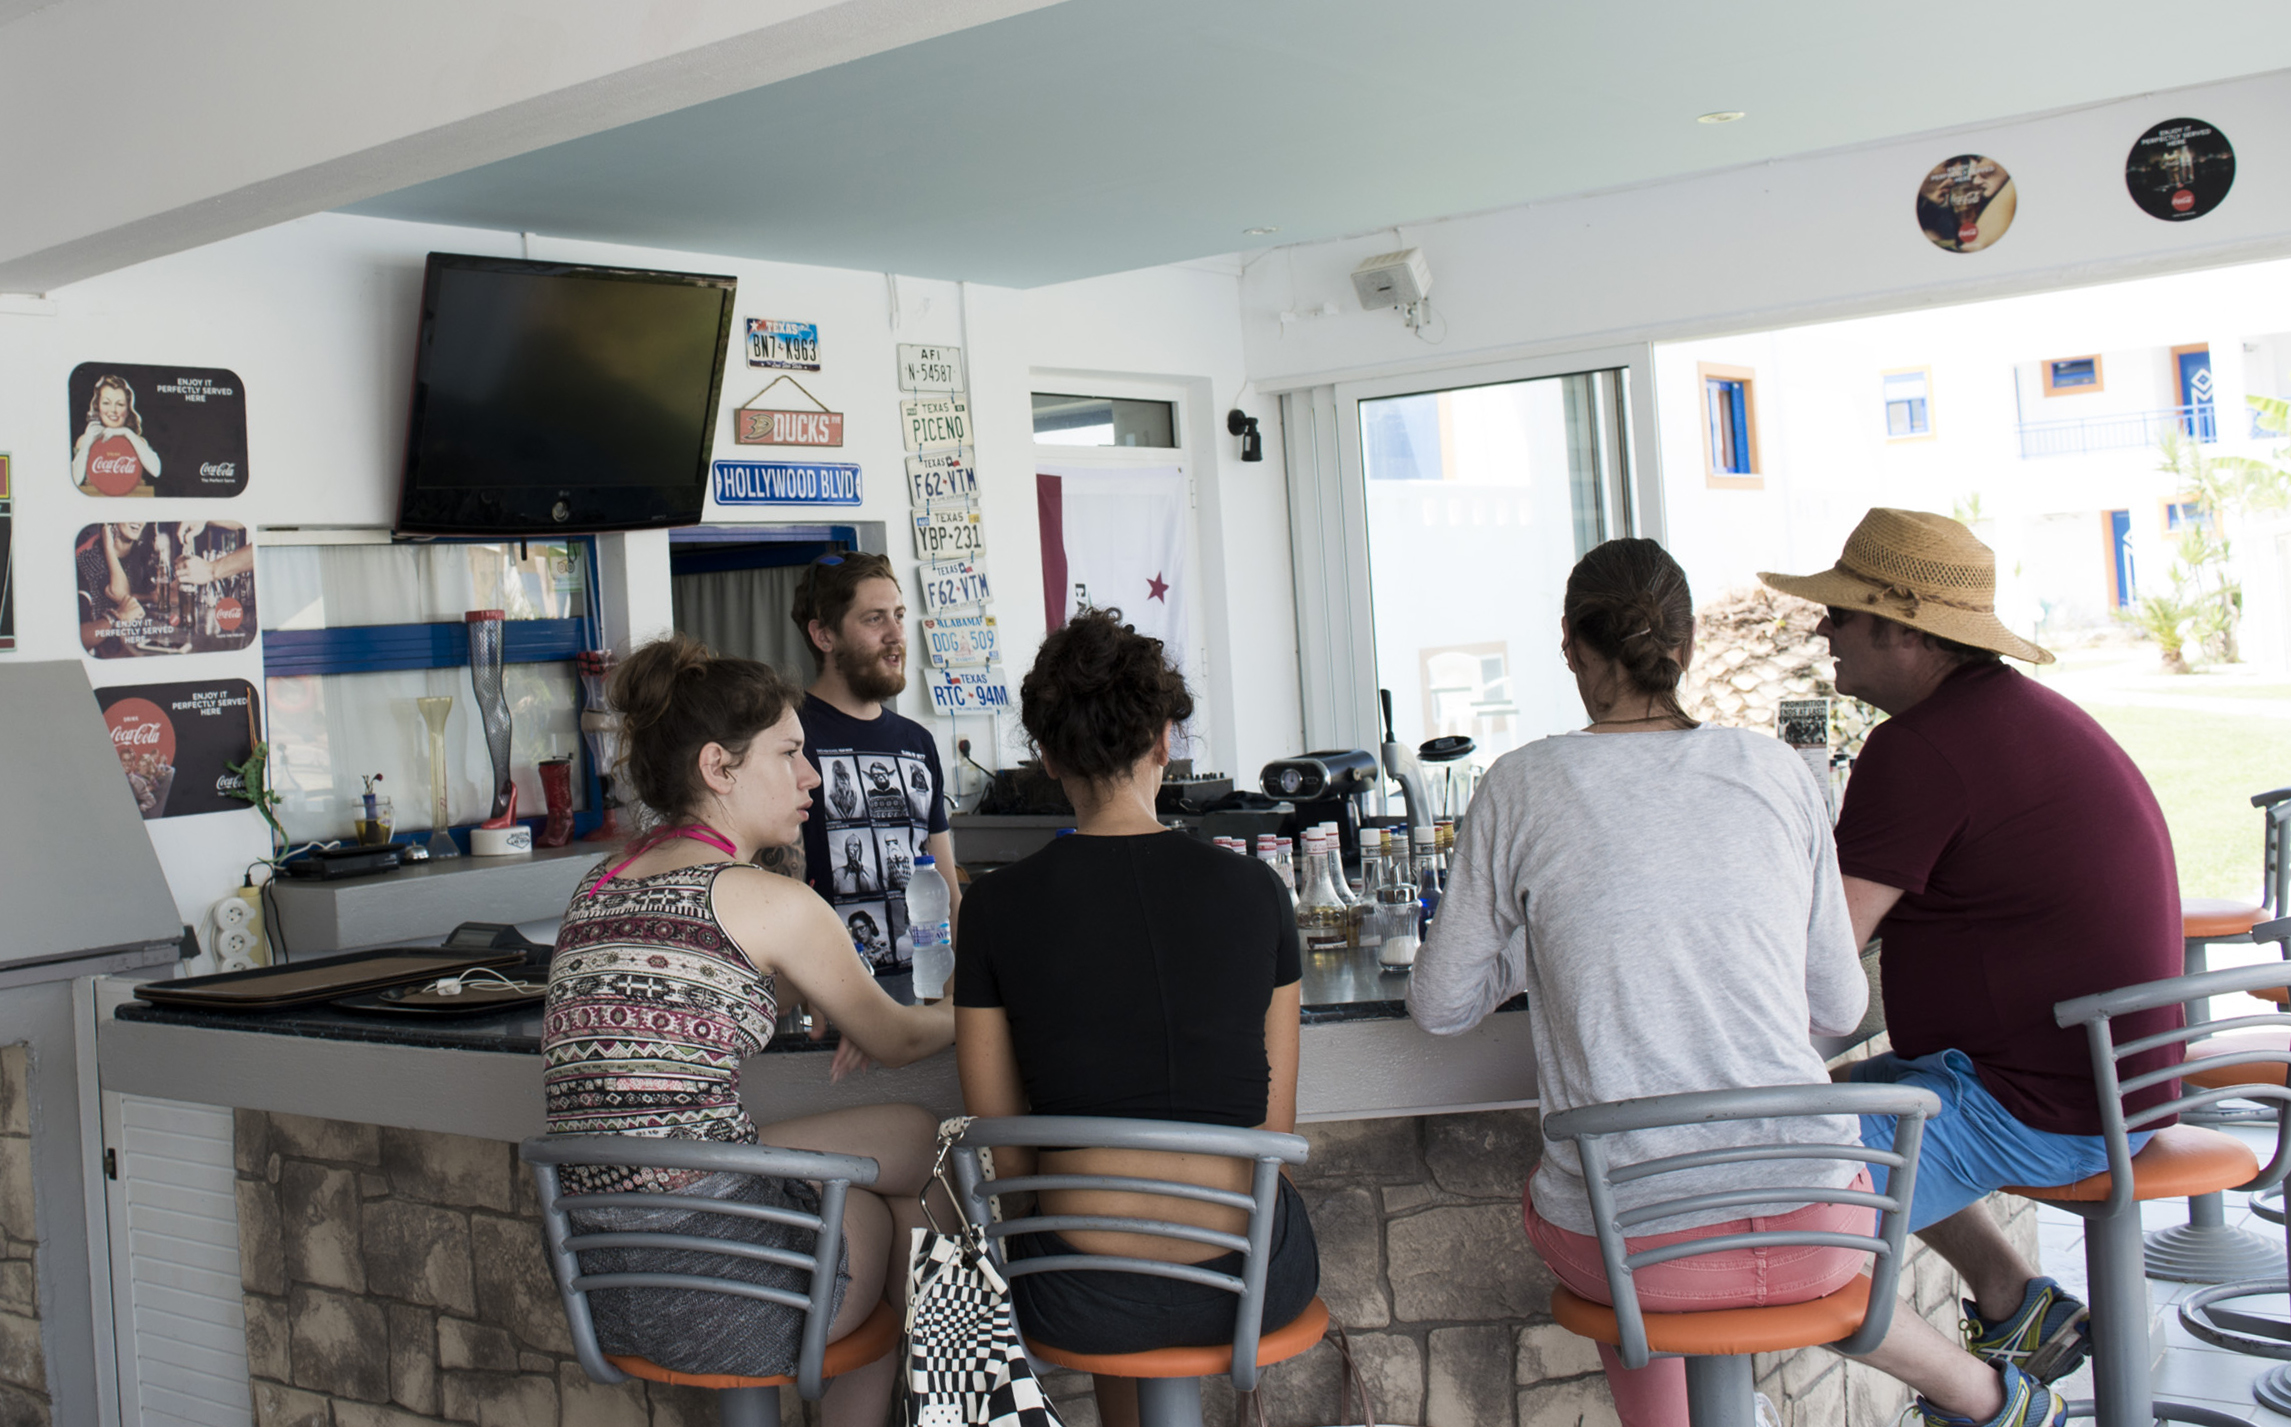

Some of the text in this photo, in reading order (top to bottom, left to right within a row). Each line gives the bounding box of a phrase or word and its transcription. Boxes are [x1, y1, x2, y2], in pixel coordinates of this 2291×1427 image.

[765, 321, 799, 335] TEXAS
[753, 334, 817, 362] BN7 K963
[177, 377, 212, 387] ENJOY IT
[157, 384, 233, 396] PERFECTLY SERVED
[185, 394, 206, 403] HERE
[922, 402, 950, 414] TEXAS
[773, 413, 830, 443] DUCKS
[912, 415, 965, 443] PICENO
[924, 457, 946, 468] TEXAS
[723, 467, 855, 499] HOLLYWOOD BLVD
[914, 467, 977, 500] F62 VTM
[934, 512, 964, 523] TEXAS
[918, 524, 982, 551] YBP 231
[937, 564, 958, 576] TEXAS
[928, 573, 990, 608] F62 VTM
[116, 619, 153, 628] ENJOY IT
[937, 617, 981, 628] ALABAMA
[95, 626, 174, 638] PERFECTLY SERVED
[124, 636, 146, 644] HERE
[932, 630, 994, 653] DDG 509
[960, 673, 988, 684] TEXAS
[192, 690, 228, 701] ENJOY IT
[933, 685, 1009, 706] RTC 94M
[172, 697, 248, 710] PERFECTLY SERVED
[1780, 700, 1827, 708] PROHIBITION
[200, 707, 222, 716] HERE
[1780, 708, 1798, 716] ENDS
